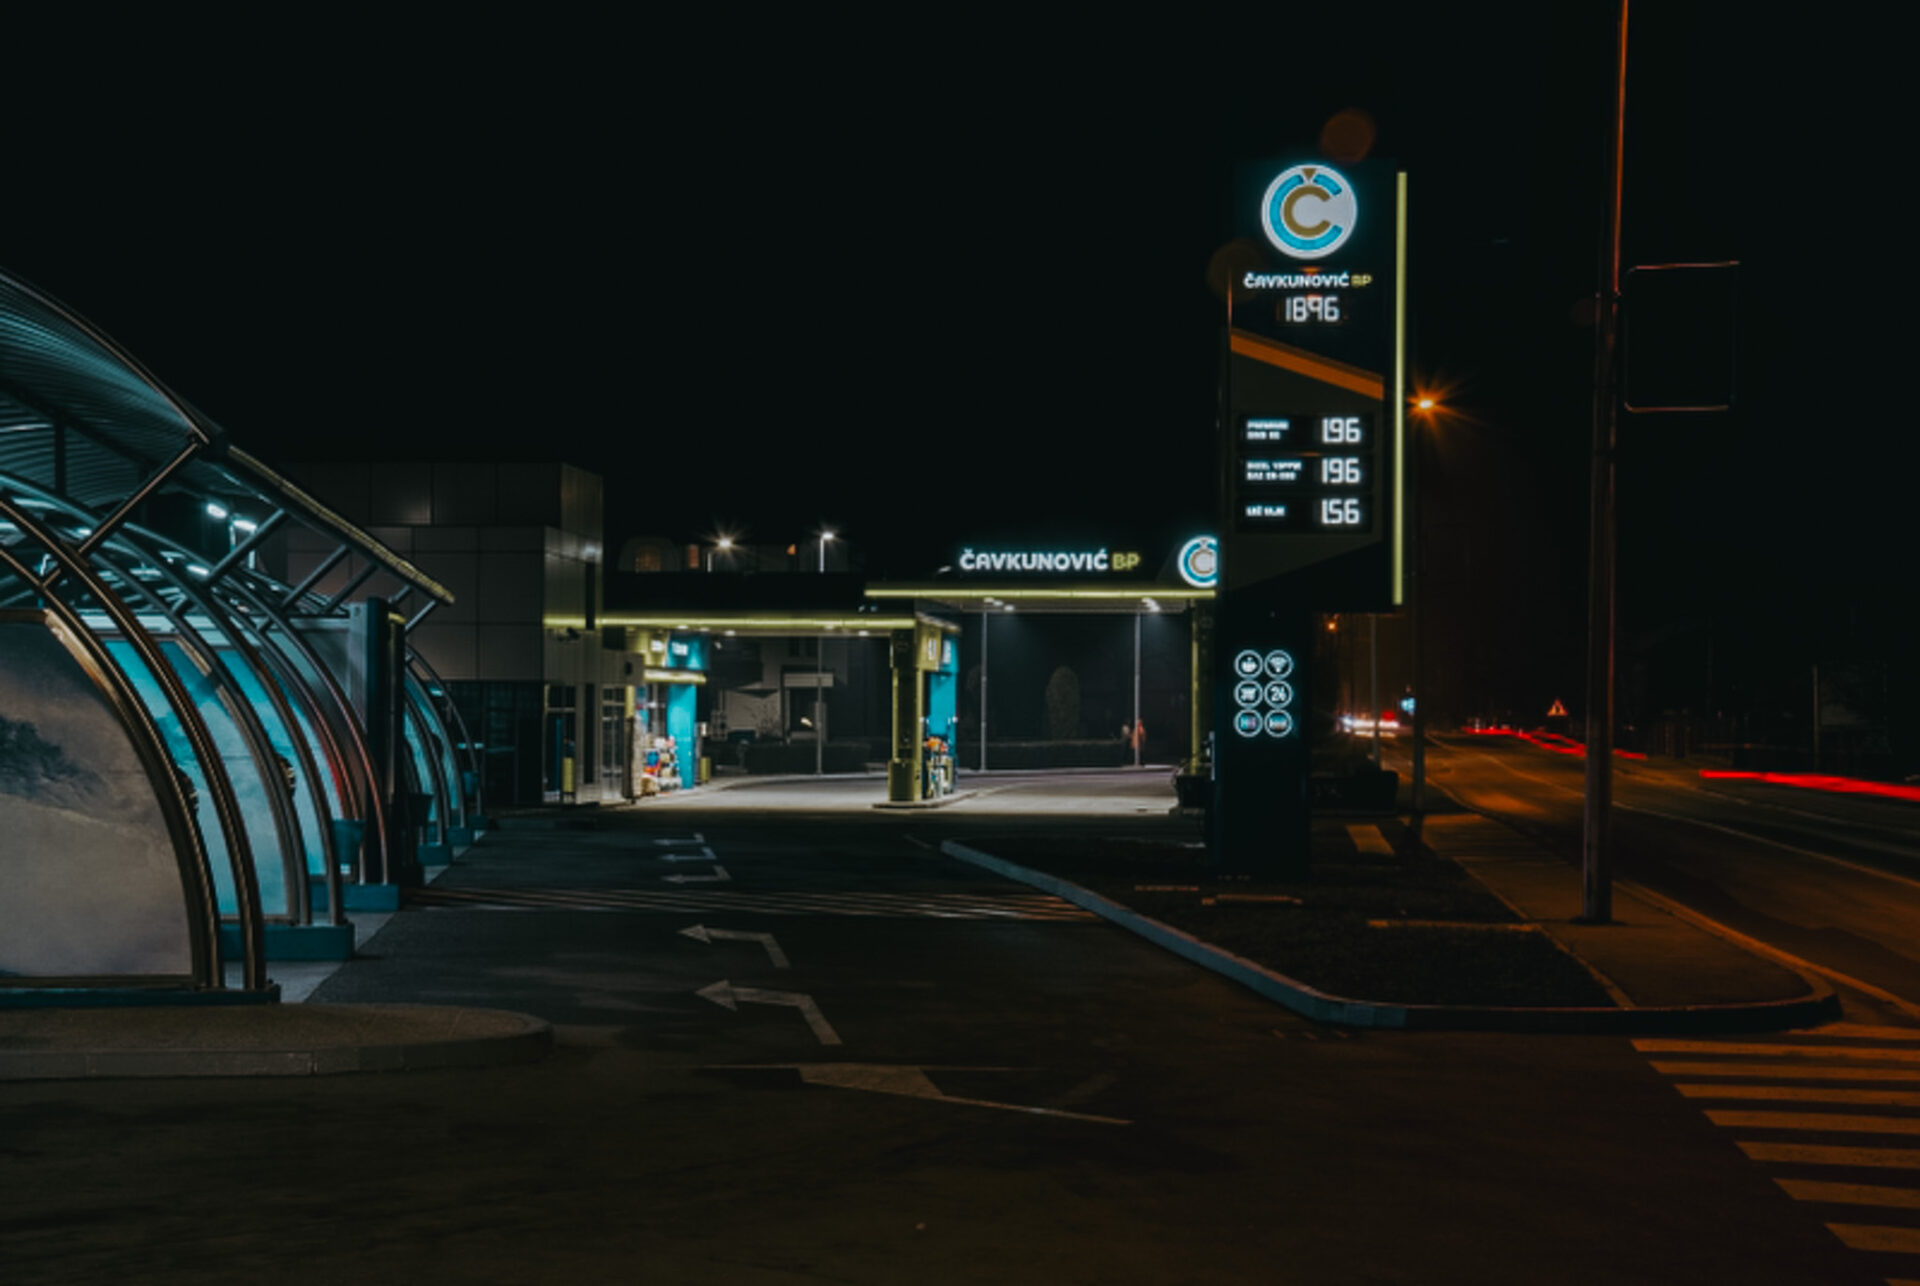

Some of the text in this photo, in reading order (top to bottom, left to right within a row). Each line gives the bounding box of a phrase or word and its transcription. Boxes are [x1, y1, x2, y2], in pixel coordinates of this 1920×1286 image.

[1243, 272, 1349, 289] ČAVKUNOVIĆ
[959, 548, 1141, 571] ČAVKUNOVIĆ BP
